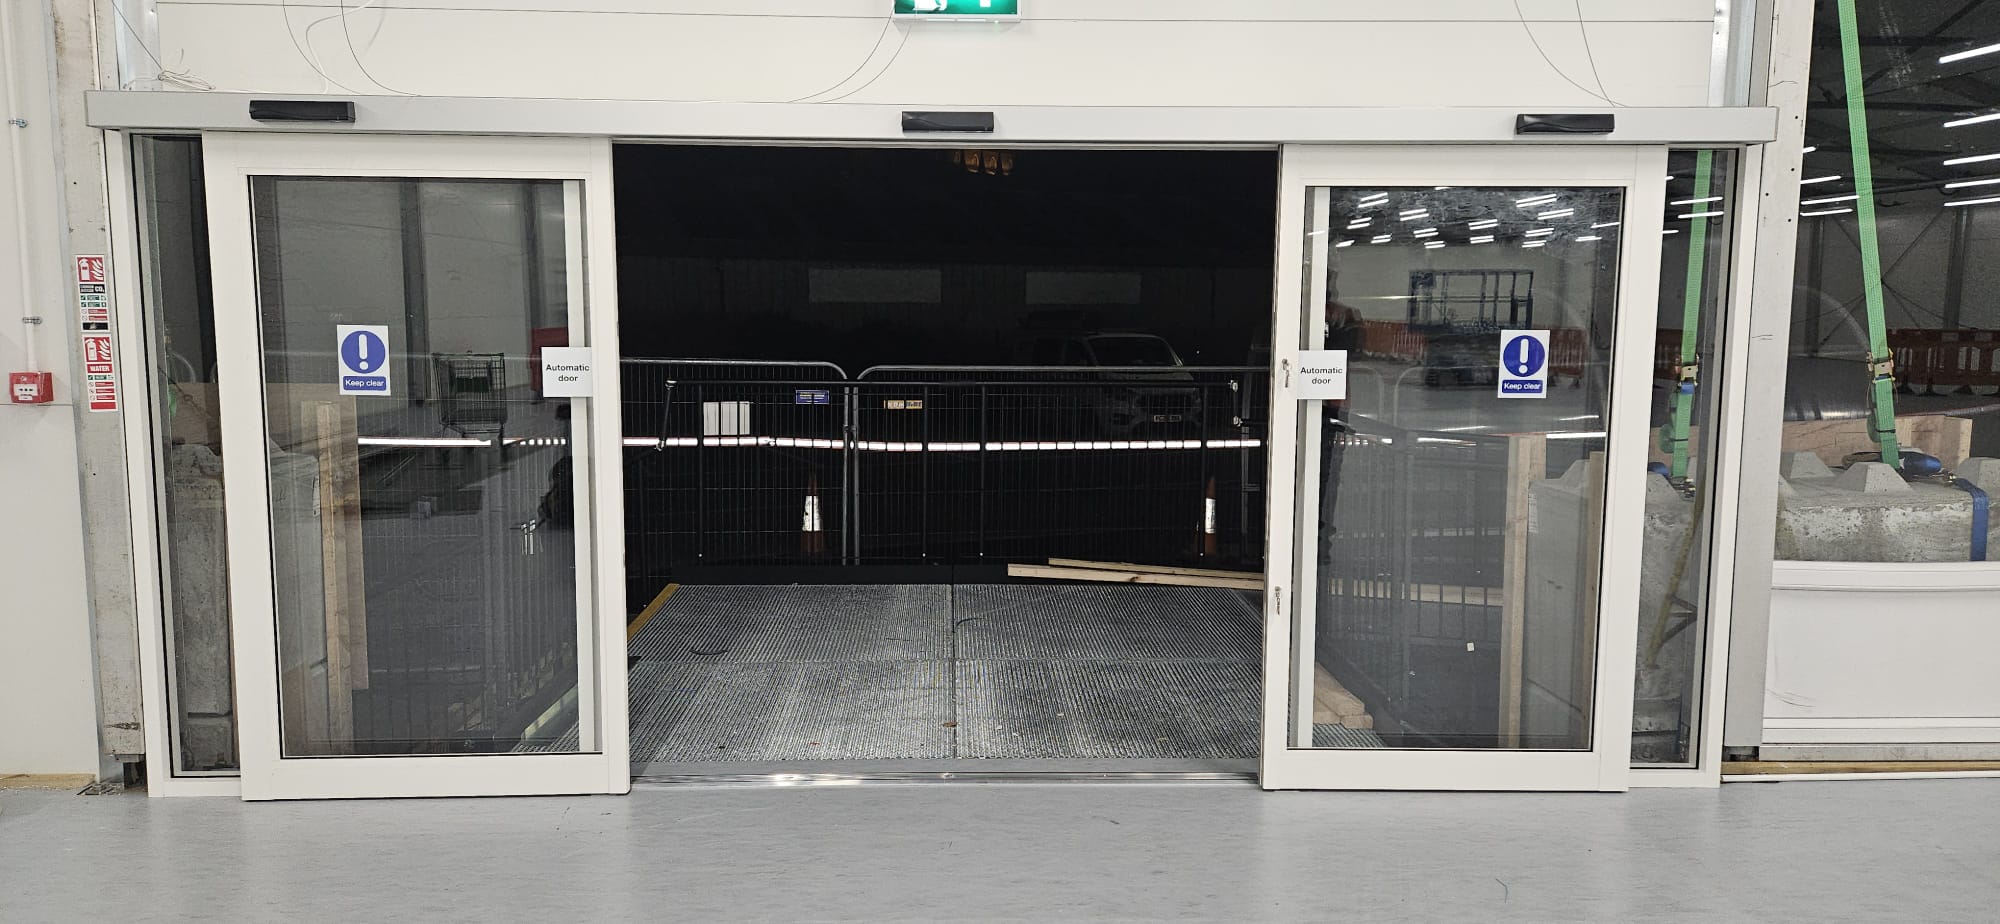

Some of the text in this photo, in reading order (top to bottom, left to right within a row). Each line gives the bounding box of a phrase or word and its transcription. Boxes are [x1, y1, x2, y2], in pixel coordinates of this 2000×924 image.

[1300, 366, 1343, 374] Automatic
[557, 374, 579, 382] door
[1311, 377, 1332, 385] door
[345, 379, 385, 388] Keep clear
[1503, 382, 1542, 390] Keep clear
